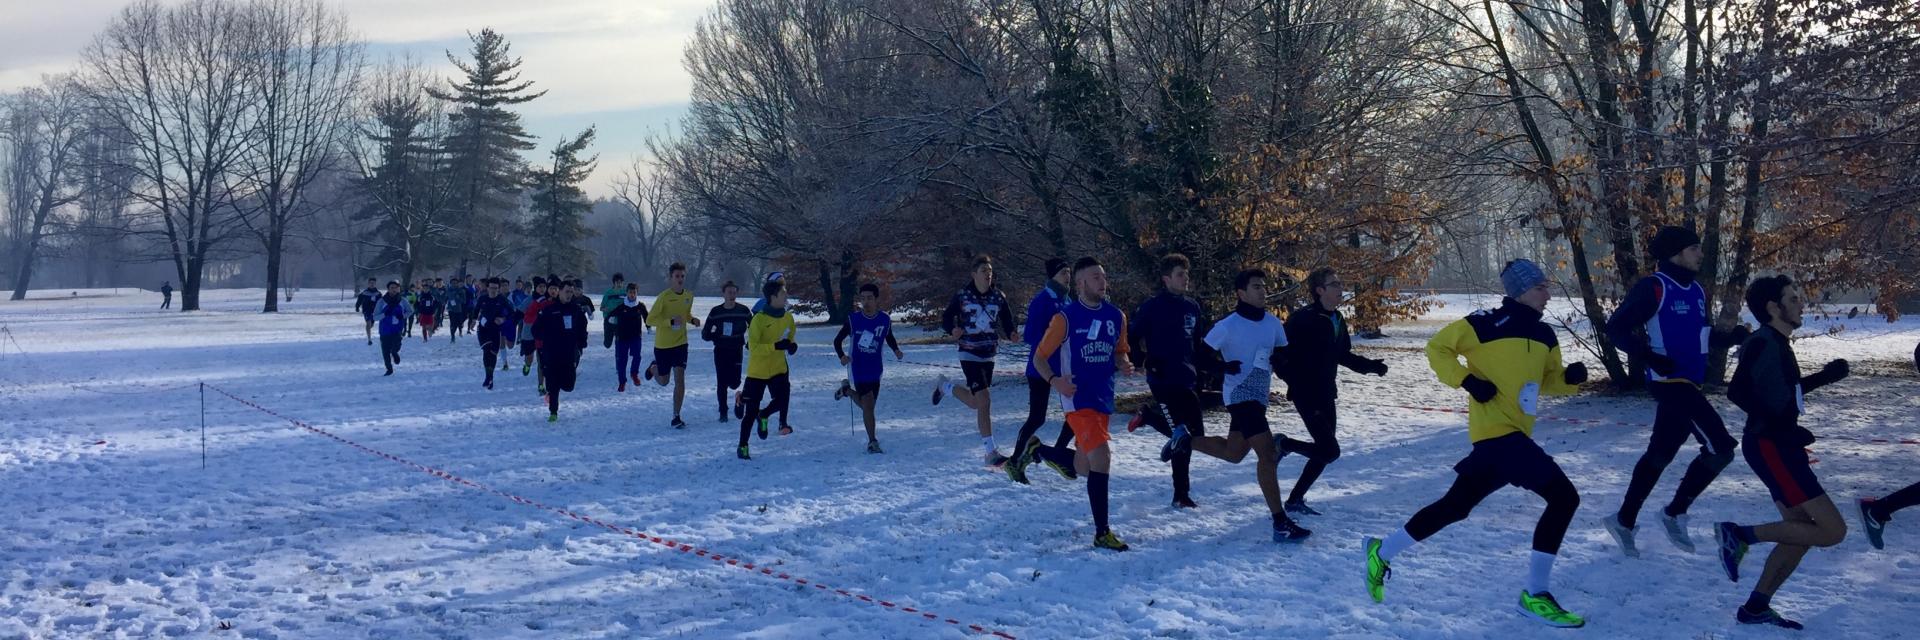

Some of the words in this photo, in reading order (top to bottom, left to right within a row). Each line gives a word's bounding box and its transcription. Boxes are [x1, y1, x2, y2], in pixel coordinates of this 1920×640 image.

[873, 325, 885, 337] 17
[1106, 319, 1115, 336] 8
[1080, 342, 1094, 358] ITIS
